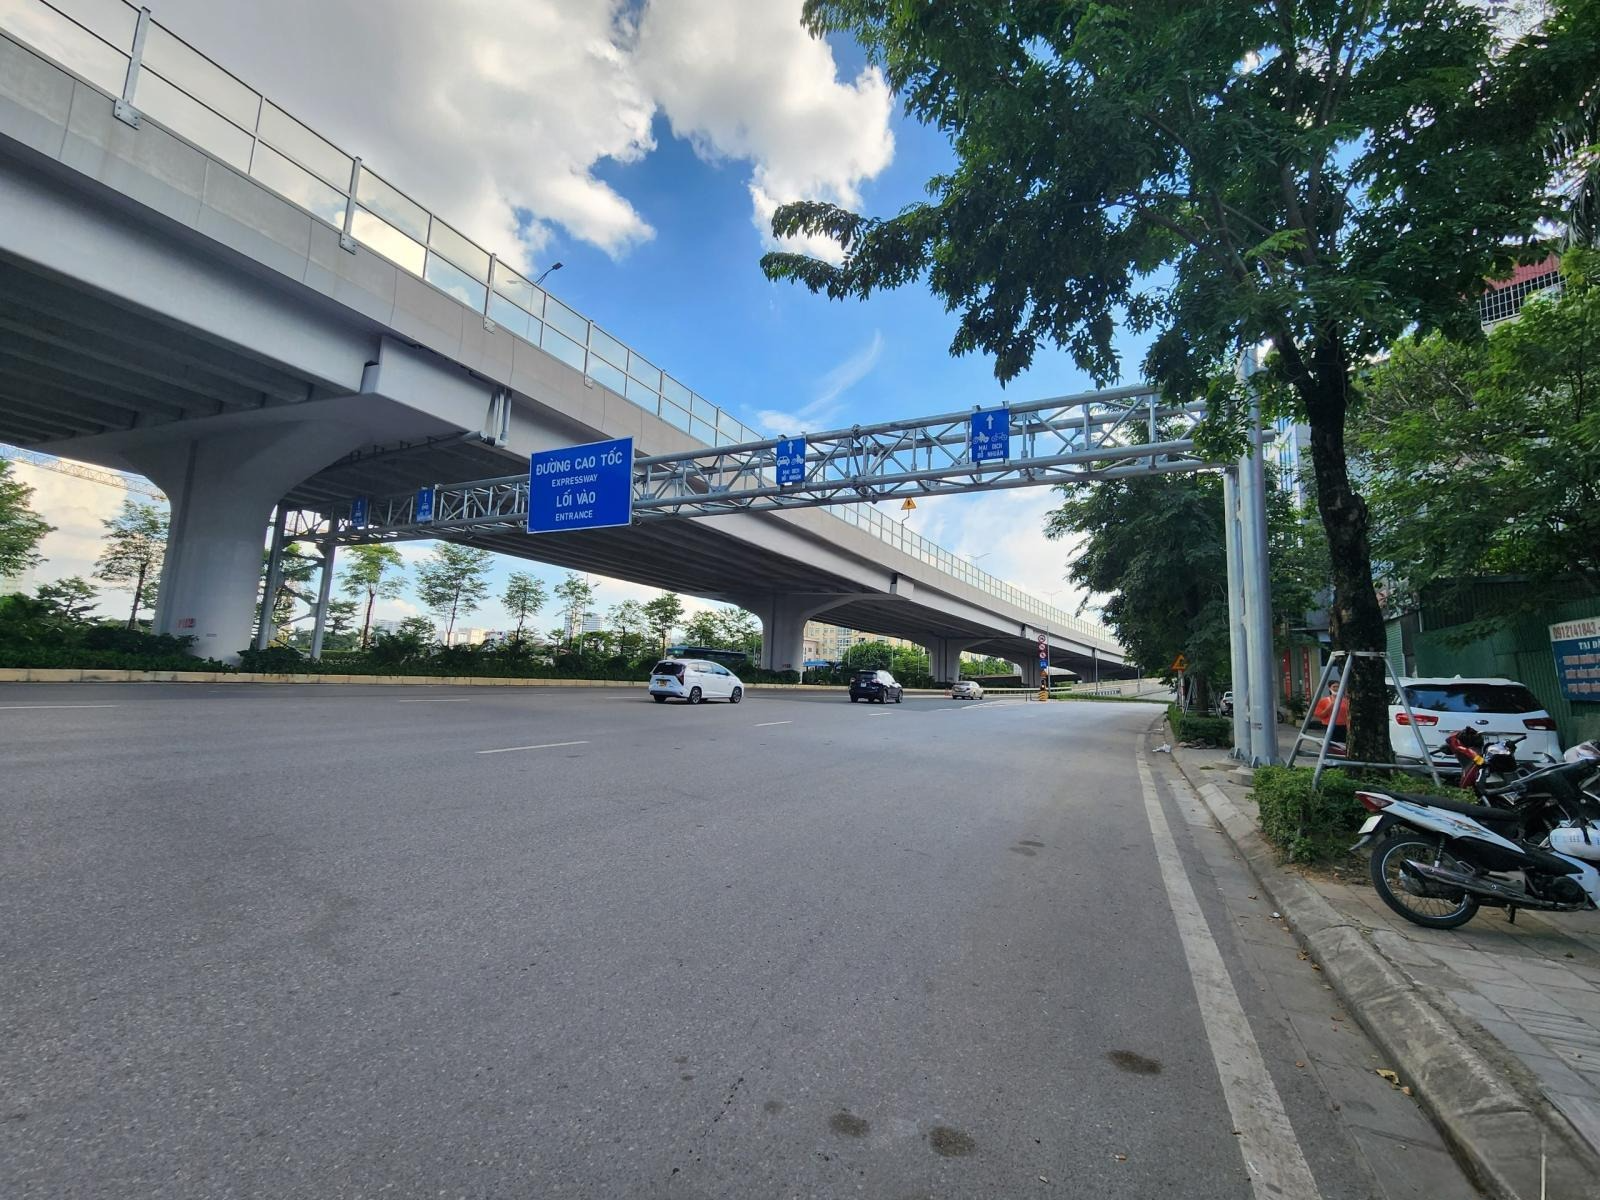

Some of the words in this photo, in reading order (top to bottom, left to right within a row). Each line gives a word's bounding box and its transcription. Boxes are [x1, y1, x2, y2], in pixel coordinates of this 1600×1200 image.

[536, 458, 571, 476] ĐƯỜNG
[574, 456, 596, 470] CAO
[600, 446, 623, 466] TỐC
[551, 474, 598, 487] EXPRESSWAY
[556, 489, 572, 508] LỐI
[576, 489, 596, 504] VÀO
[555, 510, 593, 521] ENTRANCE
